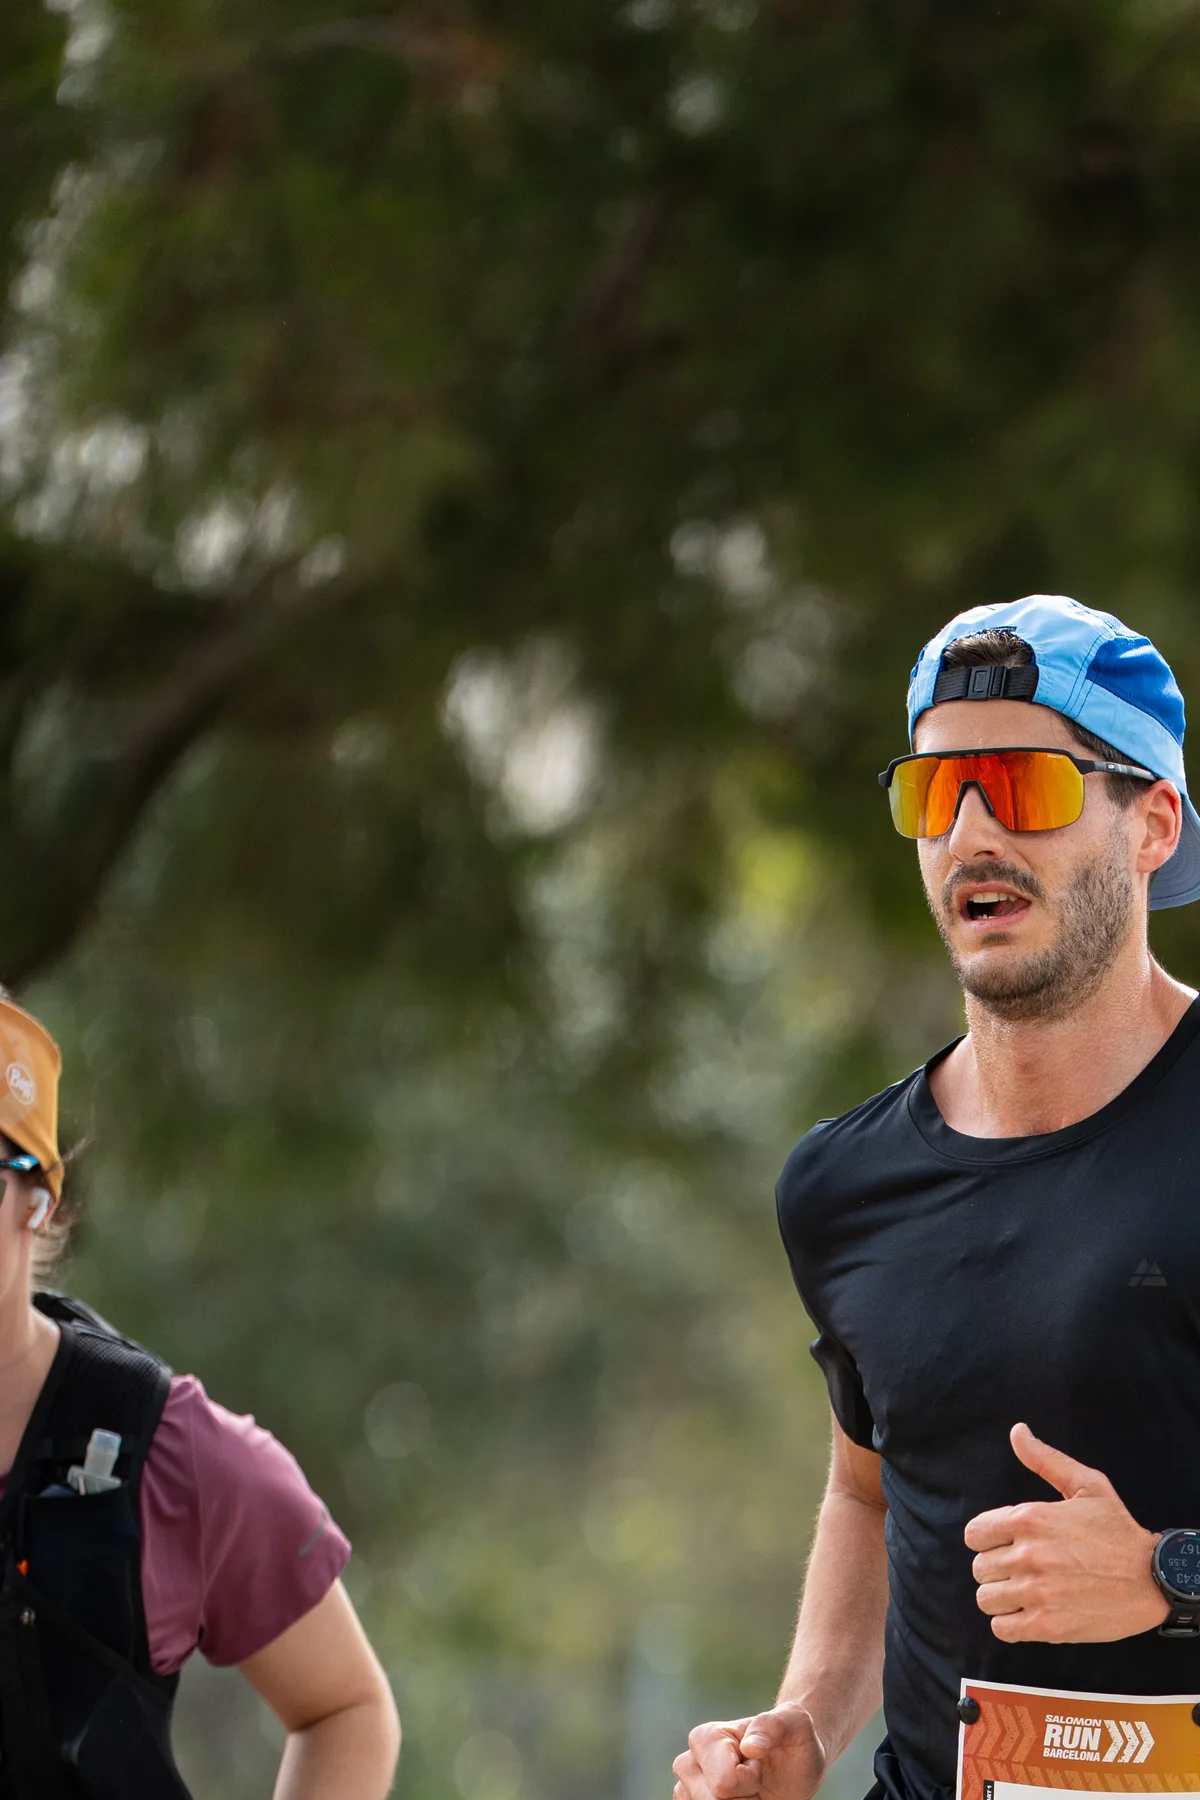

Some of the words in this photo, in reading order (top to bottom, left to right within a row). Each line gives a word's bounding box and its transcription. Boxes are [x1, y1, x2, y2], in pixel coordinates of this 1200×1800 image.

[1180, 1544, 1200, 1554] 167
[1044, 1714, 1102, 1728] SALOMON
[1043, 1723, 1102, 1751] RUN
[1043, 1747, 1101, 1762] BARCELONA
